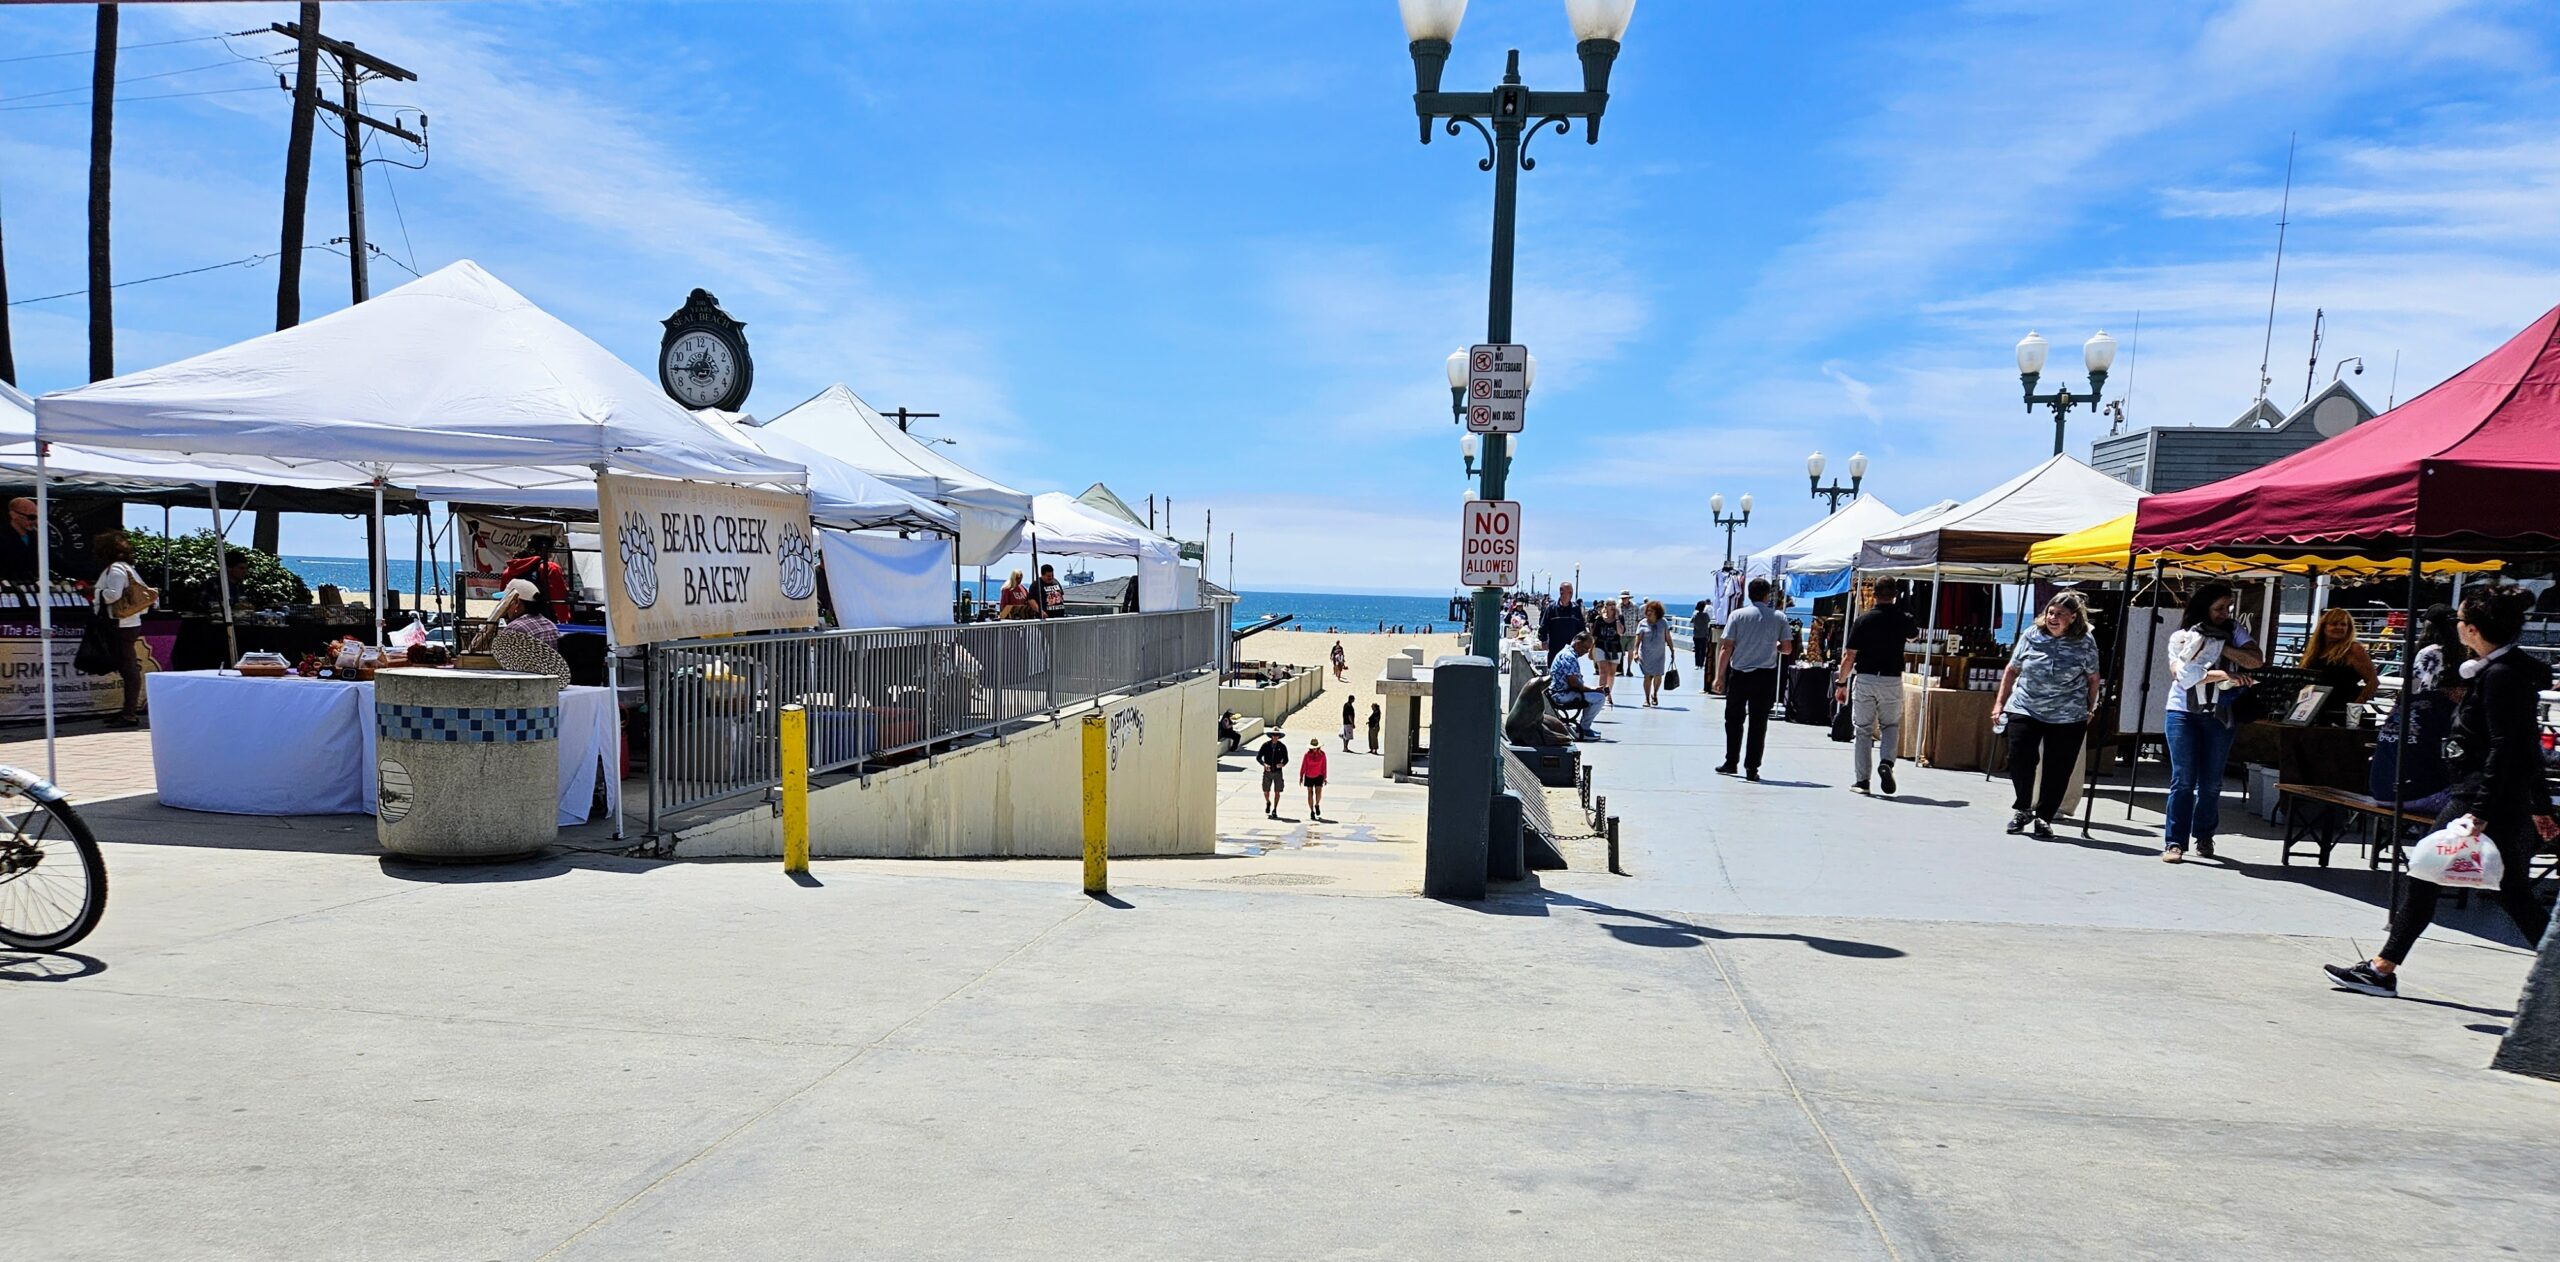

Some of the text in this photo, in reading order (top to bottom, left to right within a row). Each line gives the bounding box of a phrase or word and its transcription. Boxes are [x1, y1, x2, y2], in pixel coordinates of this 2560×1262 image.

[673, 312, 731, 329] SEAL BEACH
[685, 341, 692, 352] 11
[696, 337, 705, 348] 12
[711, 342, 716, 353] 1
[675, 352, 684, 362] 10
[720, 352, 727, 363] 2
[1494, 352, 1504, 363] NO
[725, 365, 731, 376] 3
[1494, 362, 1522, 372] SKATEBOARD
[678, 377, 684, 387] 8
[721, 377, 728, 388] 4
[1493, 378, 1503, 389] NO
[687, 388, 692, 397] 7
[700, 391, 706, 402] 6
[713, 387, 720, 398] 5
[1493, 389, 1523, 400] ROLLERSKATE
[1492, 411, 1516, 421] NO DOGS
[1475, 512, 1510, 535] NO
[661, 512, 771, 555] BEAR CREEK
[1468, 539, 1515, 555] DOGS
[1466, 559, 1514, 574] ALLOWED
[684, 566, 750, 606] BAKERY
[2, 624, 22, 636] The
[18, 683, 41, 697] Aged
